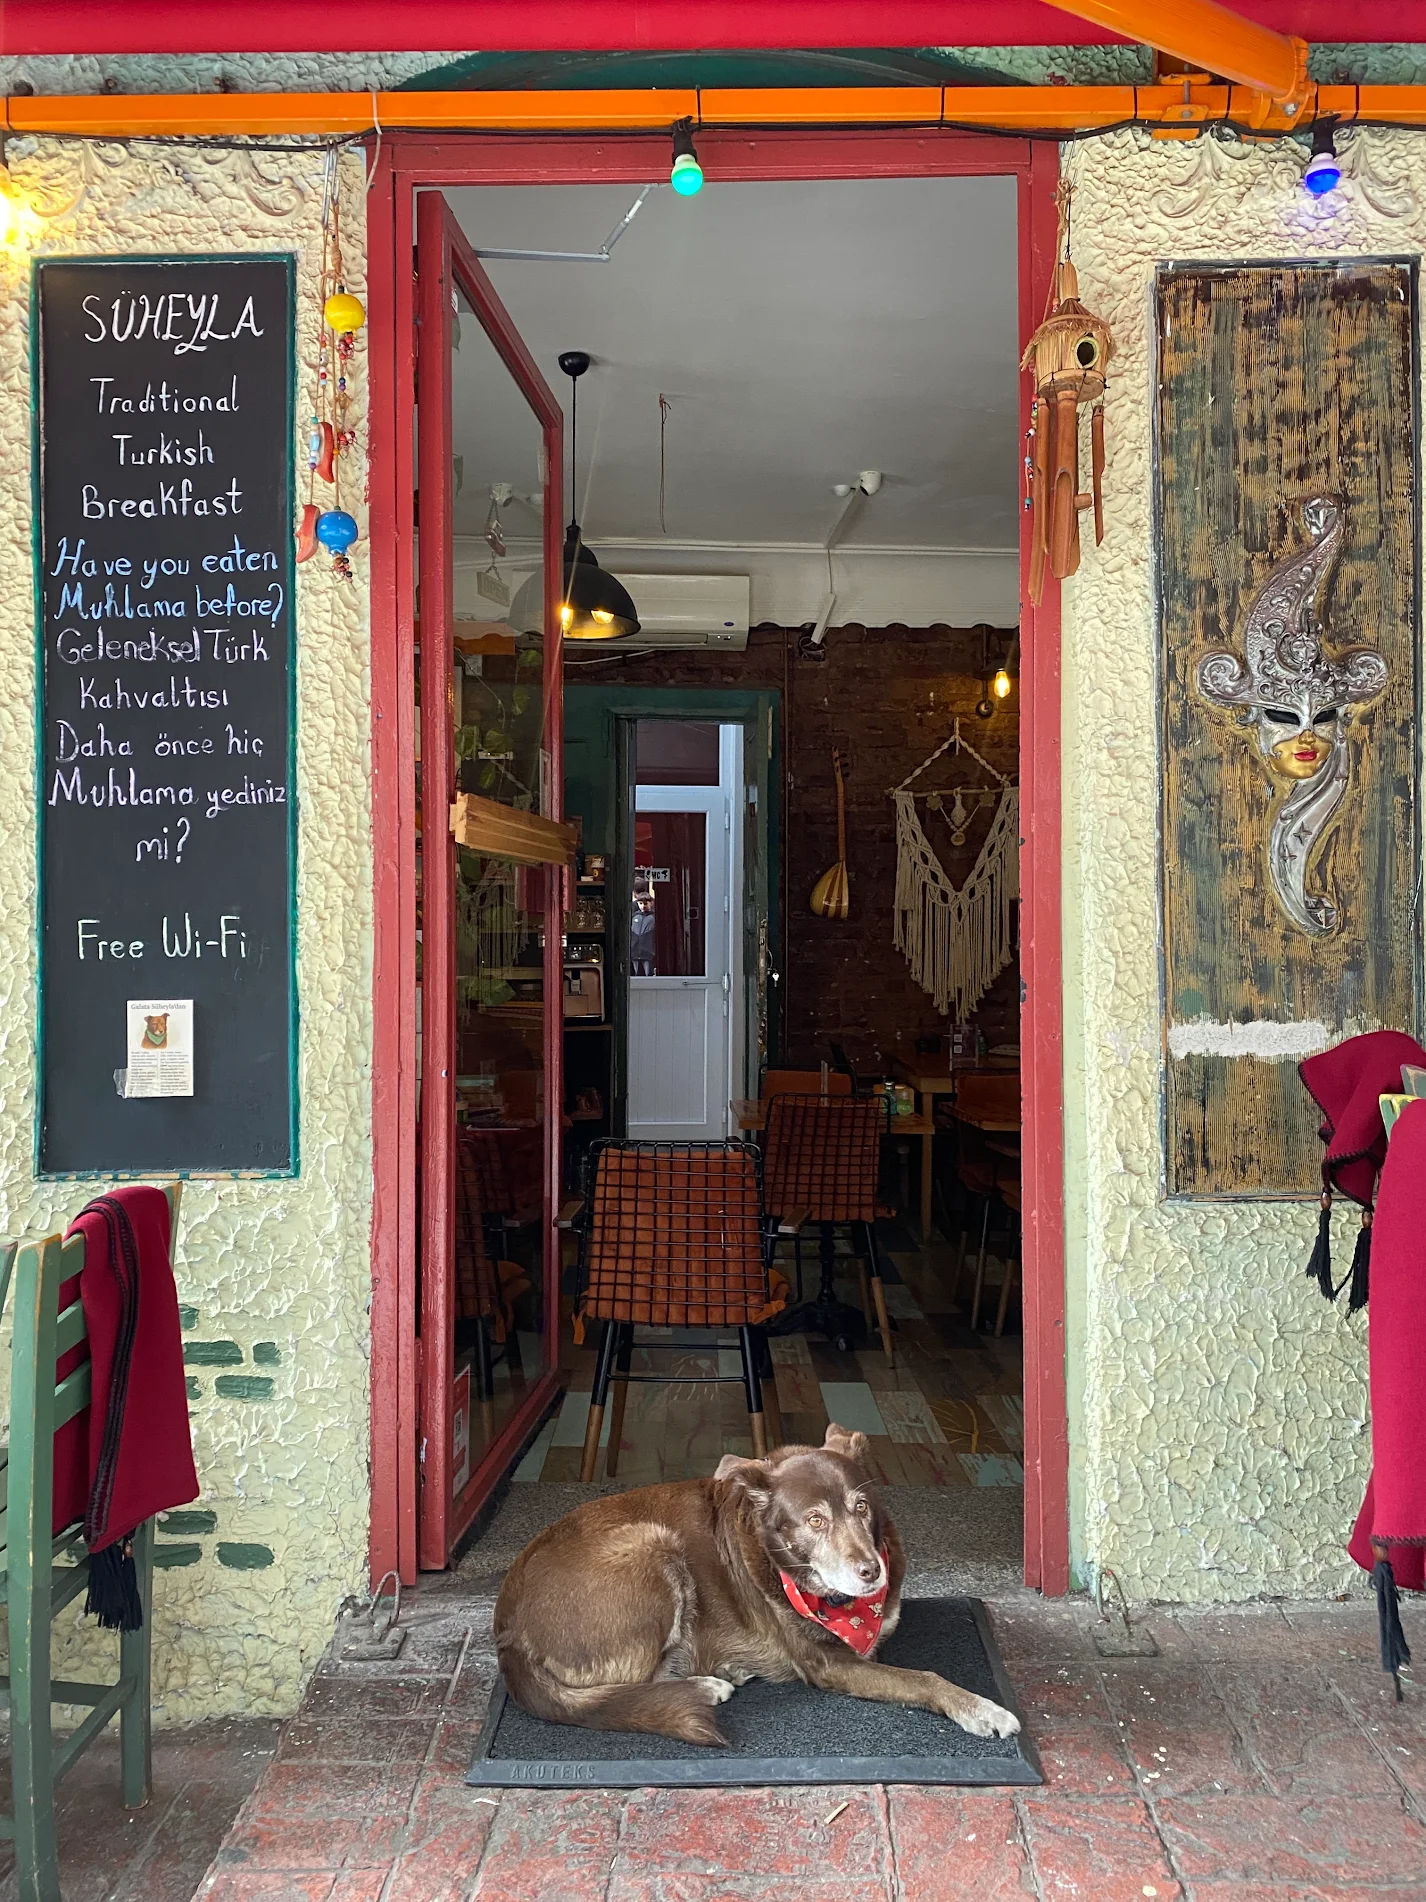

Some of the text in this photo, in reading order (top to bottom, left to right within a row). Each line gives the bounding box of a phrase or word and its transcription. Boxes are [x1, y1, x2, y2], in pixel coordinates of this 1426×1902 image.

[82, 290, 264, 355] SÜHEYLA
[90, 375, 240, 413] Traditional
[112, 429, 214, 465] Turkish
[82, 477, 243, 518] Breakfast
[51, 534, 278, 589] Have you eaten
[54, 582, 283, 628] Muhlama before?
[57, 626, 270, 664] Geleneksel Türk
[80, 676, 228, 709] Kahvaltısı
[55, 720, 263, 763] Daha önce hiç
[48, 766, 286, 818] Muhlama yediniz
[136, 817, 190, 863] mi?
[77, 912, 246, 960] Free Wi-Fi
